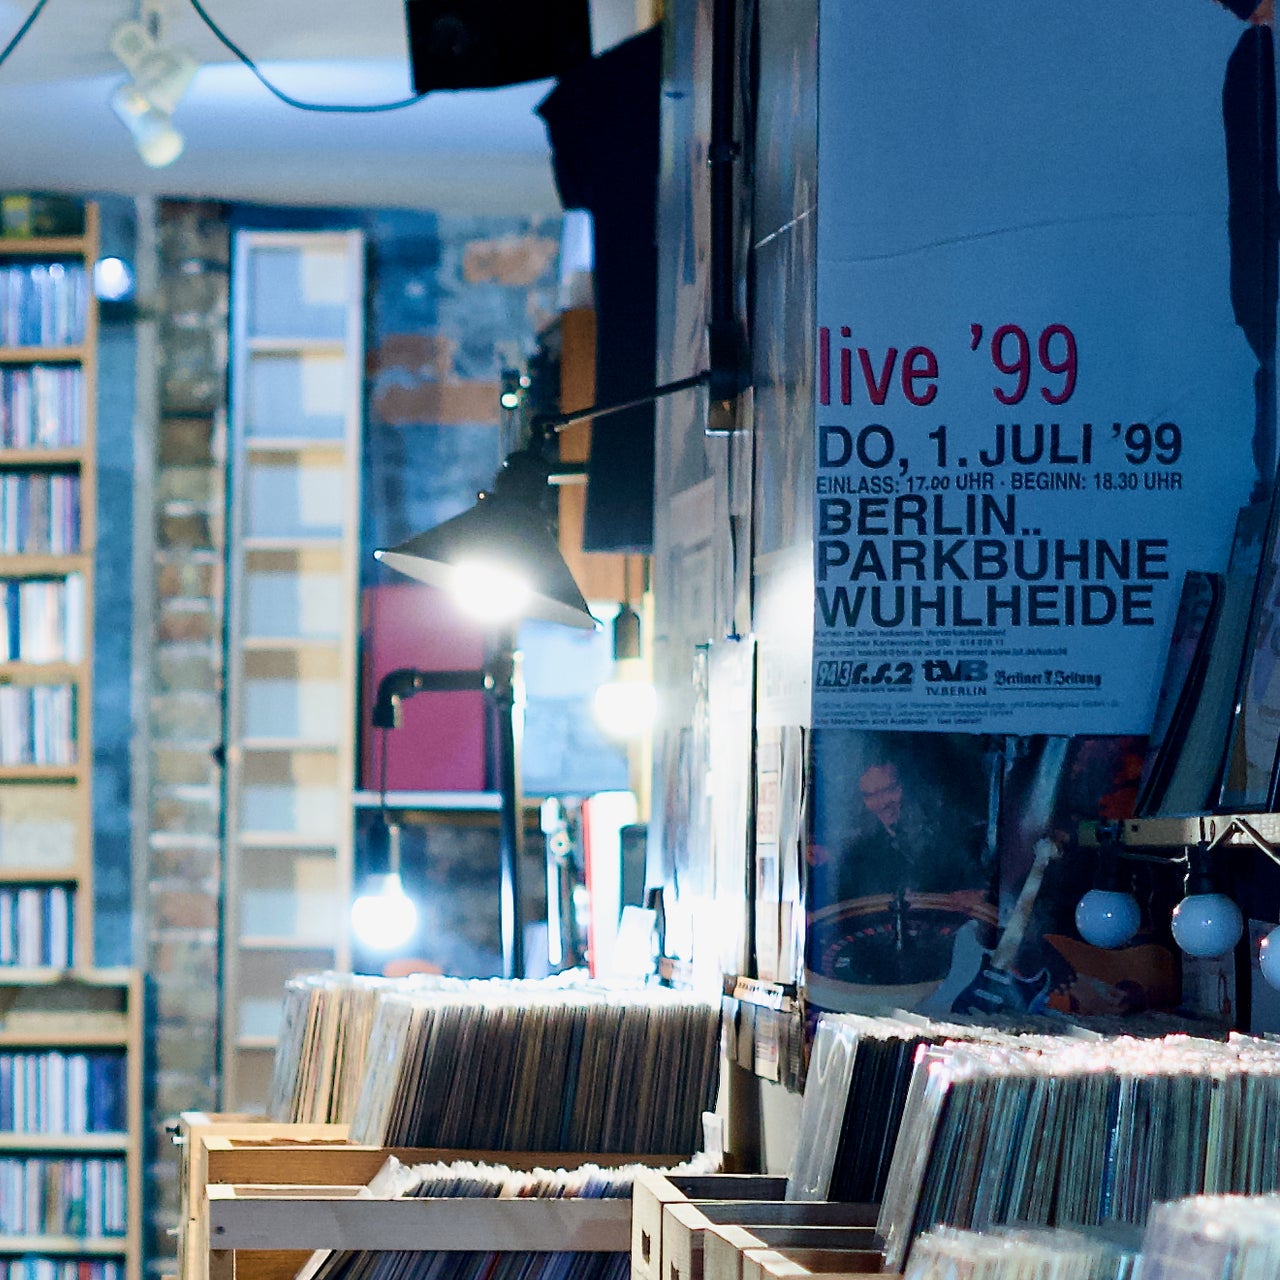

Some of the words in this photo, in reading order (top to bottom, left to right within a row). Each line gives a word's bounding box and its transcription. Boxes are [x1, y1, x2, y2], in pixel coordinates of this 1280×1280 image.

[819, 326, 939, 406] live
[970, 323, 1079, 406] '99
[819, 423, 911, 475] DO,
[928, 424, 967, 468] 1.
[980, 423, 1092, 466] JULI
[1111, 422, 1183, 464] '99
[816, 476, 901, 495] EINLASS:
[906, 476, 950, 491] 17.00
[956, 473, 994, 490] UHR
[1011, 473, 1087, 490] BEGINN:
[1094, 473, 1138, 490] 18.30
[1144, 473, 1183, 490] UHR
[819, 493, 1017, 536] BERLIN
[819, 527, 1169, 582] PARKBÜHNE
[817, 585, 1154, 628] WUHLHEIDE
[994, 669, 1043, 686] Berliner
[1054, 669, 1102, 688] Zeitung
